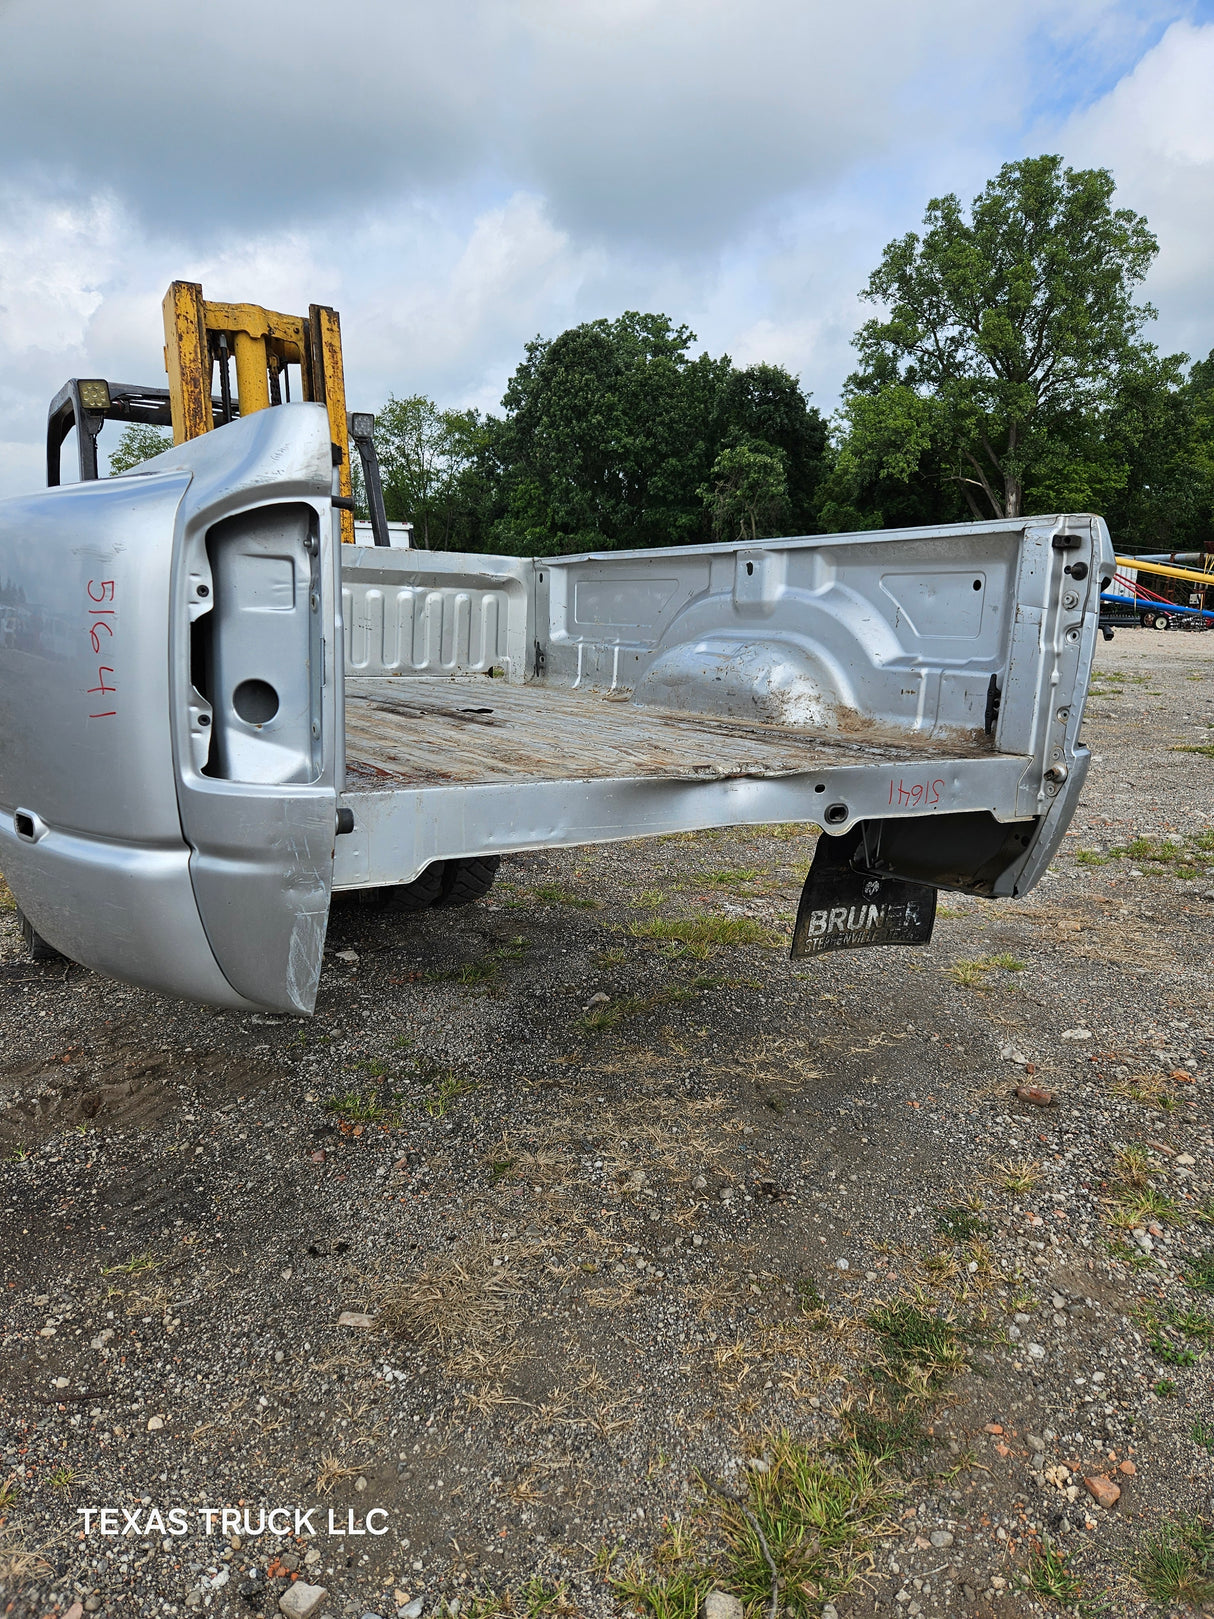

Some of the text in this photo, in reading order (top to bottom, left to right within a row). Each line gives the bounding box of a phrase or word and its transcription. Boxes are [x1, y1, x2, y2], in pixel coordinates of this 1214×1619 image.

[87, 580, 117, 718] 51641
[888, 778, 946, 807] 51641
[807, 901, 921, 937] BRUNER
